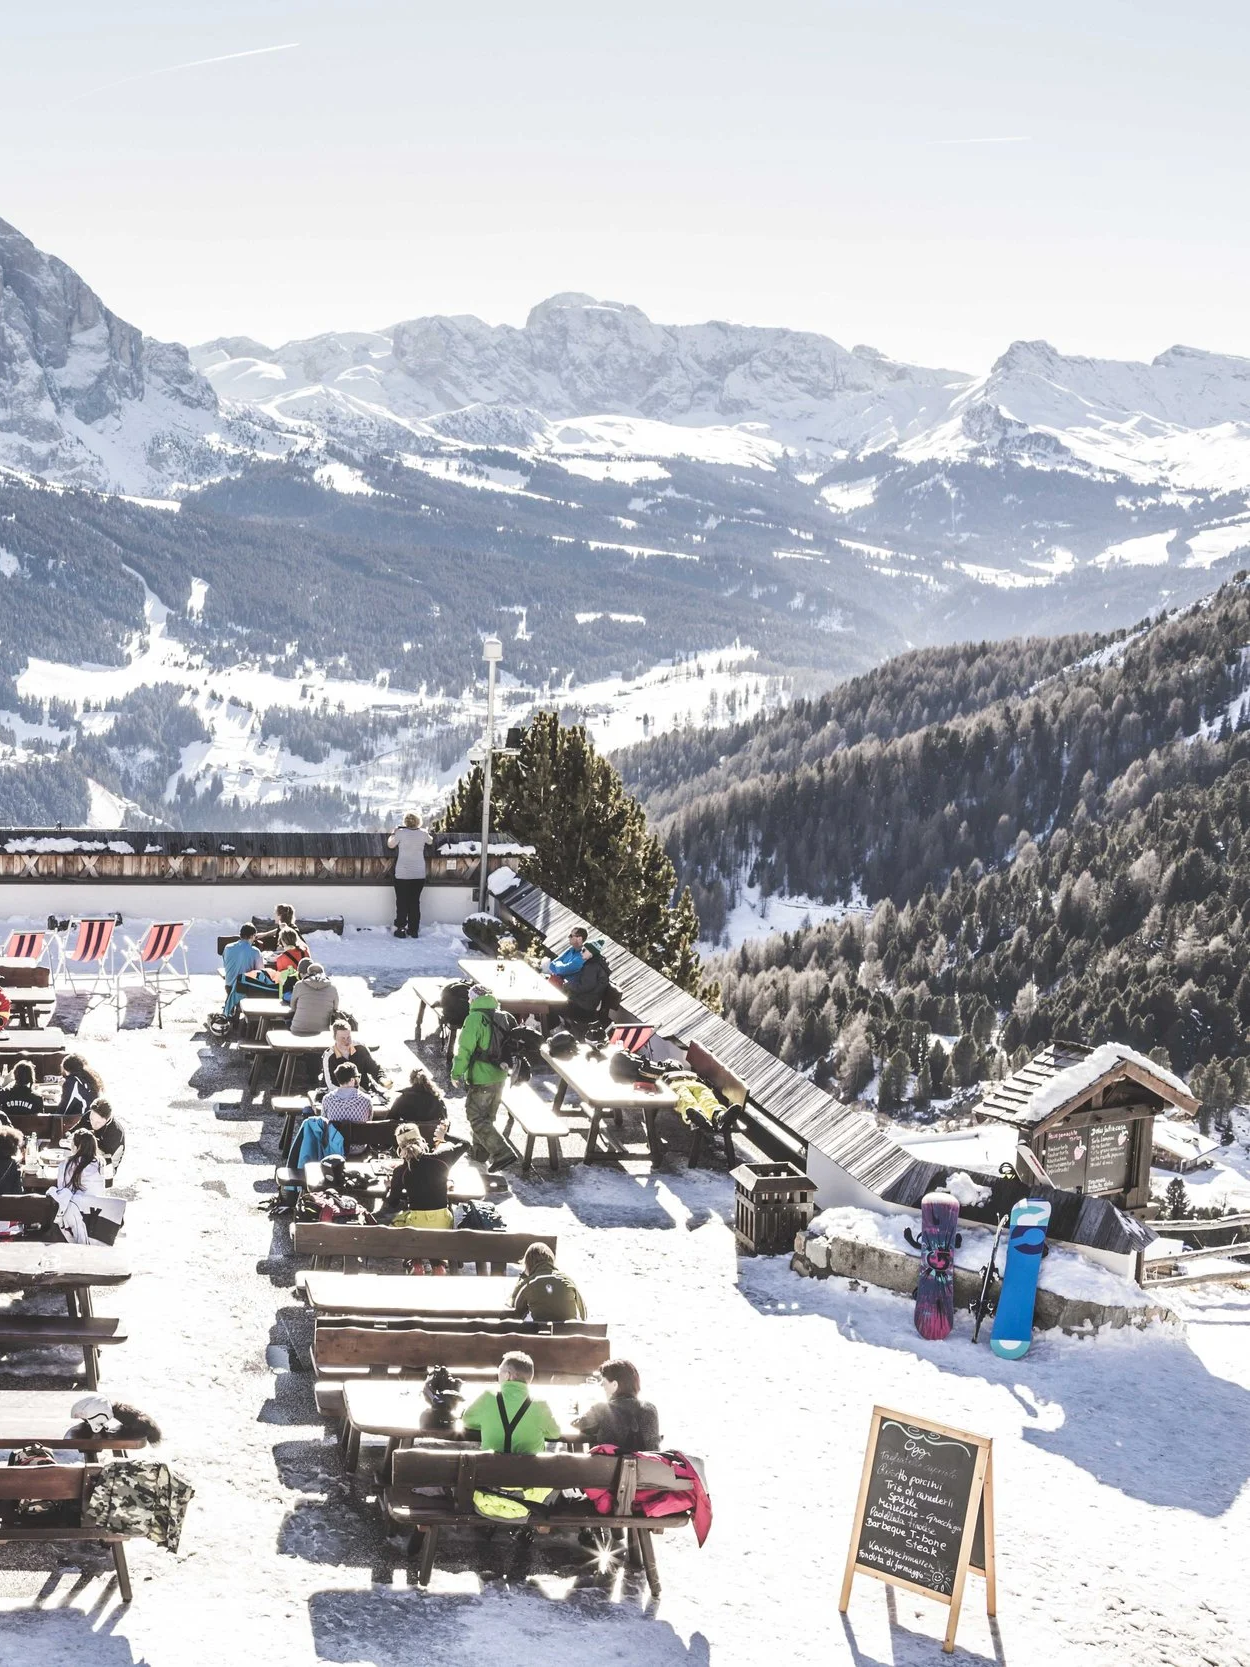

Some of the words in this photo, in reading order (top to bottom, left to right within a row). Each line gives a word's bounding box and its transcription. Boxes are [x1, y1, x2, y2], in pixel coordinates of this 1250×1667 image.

[6, 1100, 33, 1110] CORTINA
[904, 1439, 931, 1459] Oggi
[884, 1479, 903, 1493] Tris
[905, 1486, 915, 1497] di
[908, 1476, 944, 1491] porcini
[865, 1517, 907, 1537] Barbeque
[905, 1538, 938, 1558] Steak
[886, 1557, 894, 1568] di
